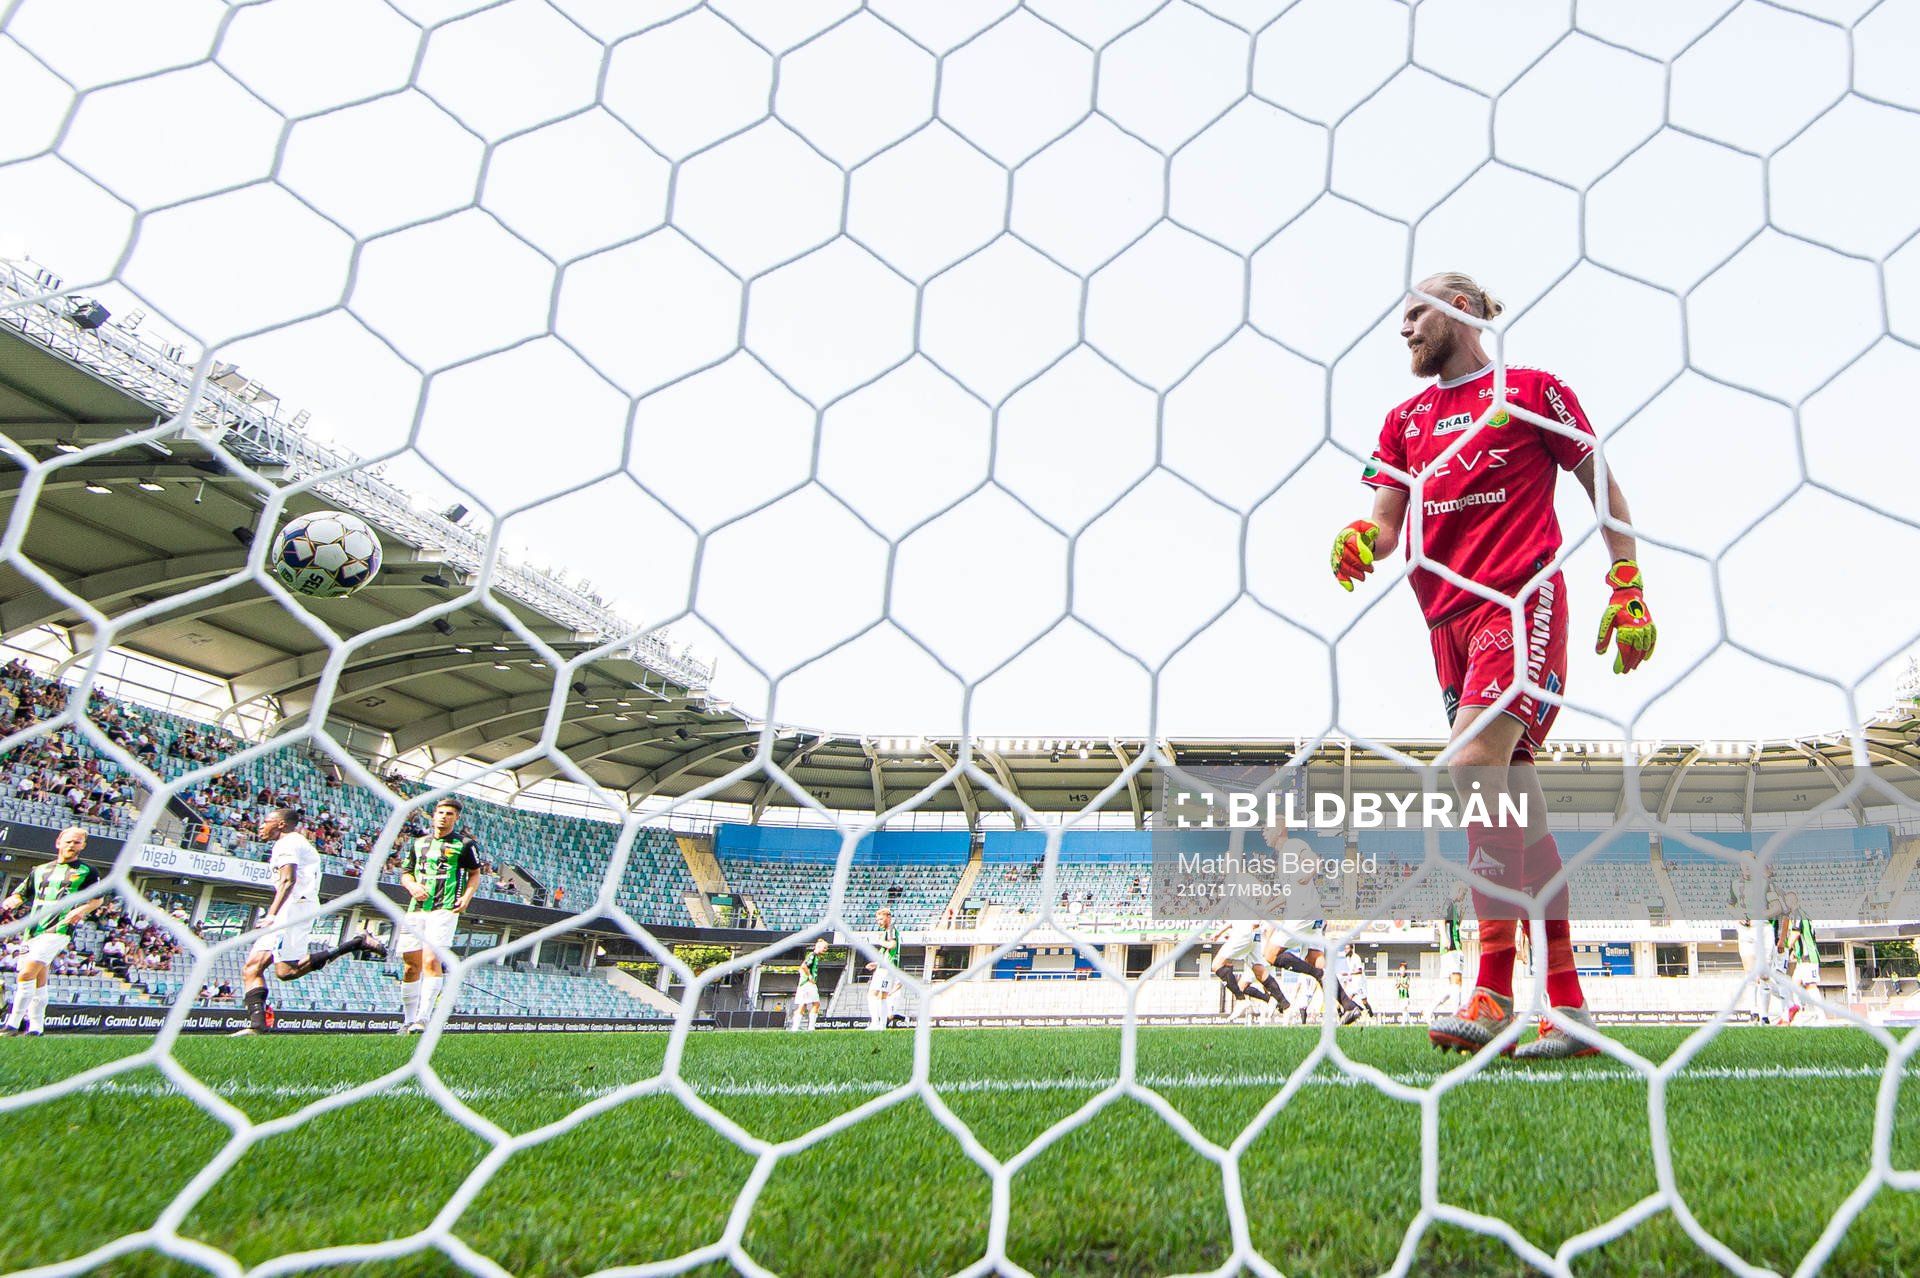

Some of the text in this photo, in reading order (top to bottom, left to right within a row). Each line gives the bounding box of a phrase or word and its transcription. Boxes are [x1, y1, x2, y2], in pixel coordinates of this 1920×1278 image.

[1437, 415, 1471, 431] SKAB
[1423, 487, 1507, 517] Tranpenad
[1069, 794, 1090, 802] H3
[1556, 795, 1573, 803] J3
[1696, 796, 1714, 804] J2
[1792, 794, 1808, 802] J1
[142, 847, 273, 882] higab higab higab
[45, 1014, 102, 1026] amla Ullevi
[105, 1015, 166, 1027] Gamla Ullevi
[199, 1017, 223, 1028] Ullevi
[277, 1018, 322, 1029] Gamla Ullevi
[324, 1019, 367, 1029] Gamla Ullevi
[368, 1020, 389, 1030] Gamla
